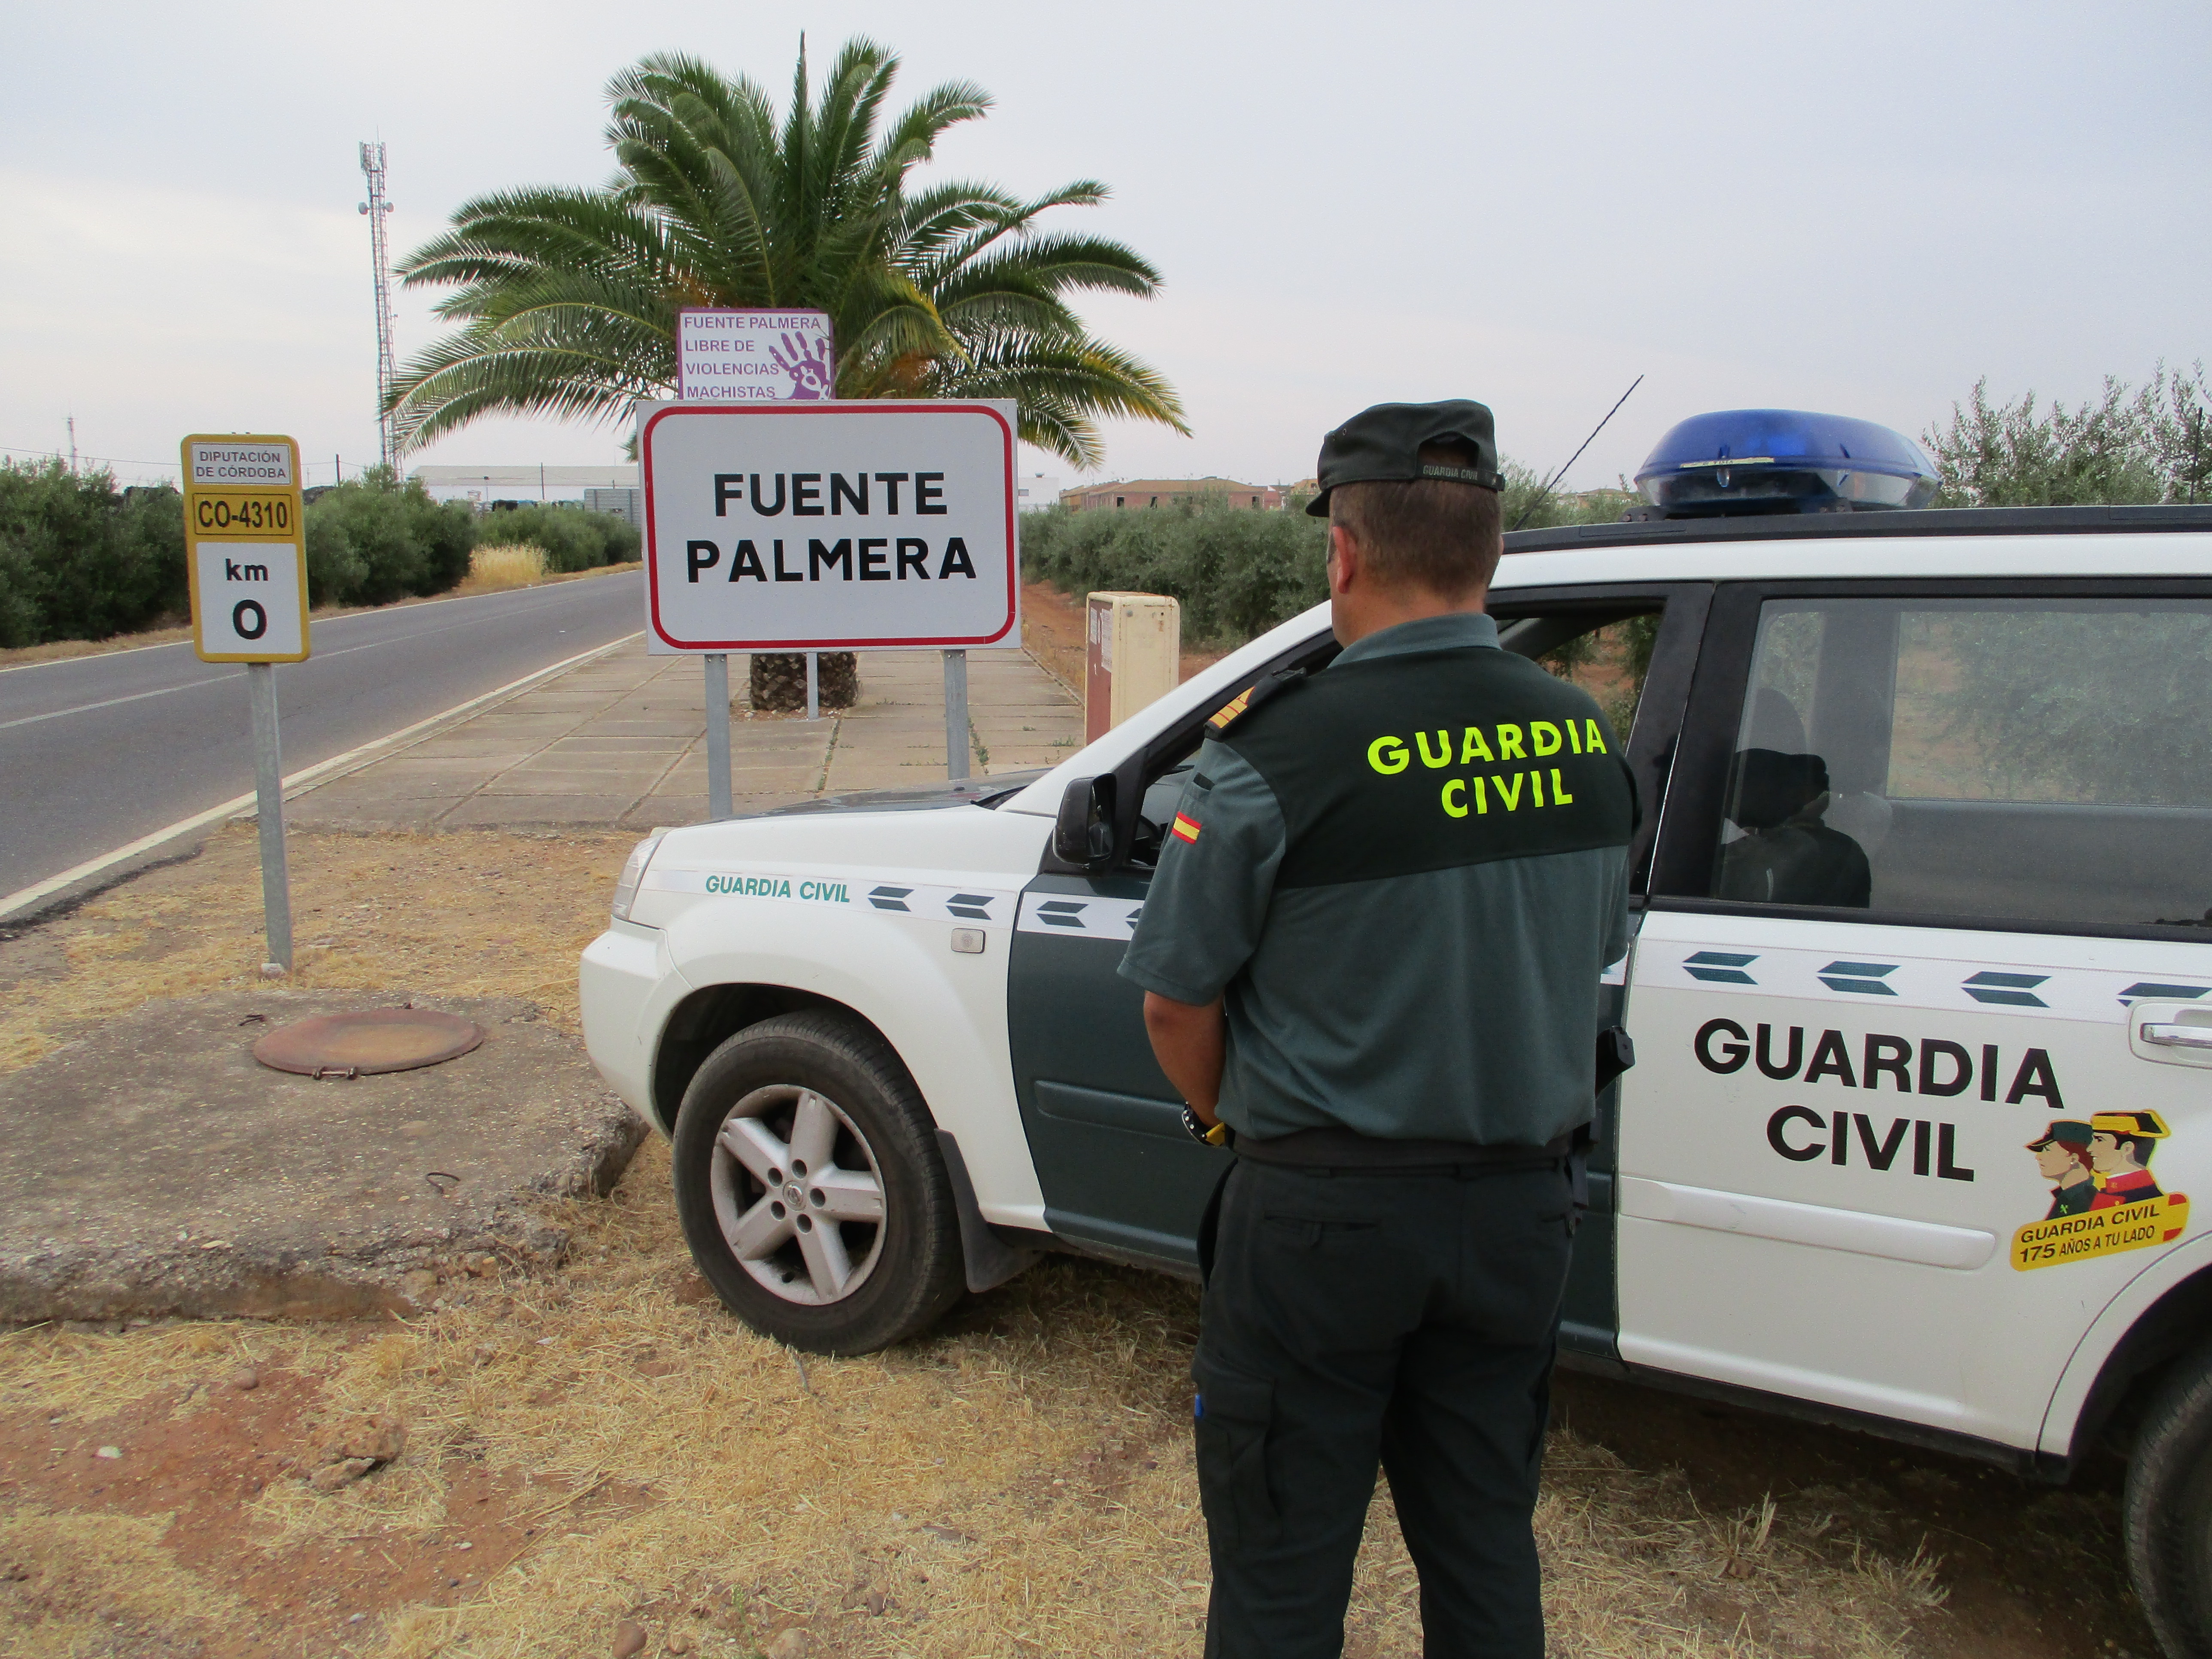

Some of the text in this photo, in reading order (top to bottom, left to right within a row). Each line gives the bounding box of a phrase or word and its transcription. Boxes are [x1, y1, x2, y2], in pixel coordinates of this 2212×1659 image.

[684, 317, 821, 329] FUENTE PALMERA
[686, 340, 755, 352] LIBRE DE
[686, 363, 779, 375] VIOLENCIAS
[687, 386, 775, 398] MACHISTAS
[200, 450, 280, 463] DIPUTACIÓN
[197, 465, 286, 478] DE CÓRDOBA
[1423, 465, 1477, 480] GUARDIA CIVIL
[714, 472, 948, 517] FUENTE
[198, 500, 288, 528] CO-4310
[225, 558, 269, 581] km
[687, 537, 976, 583] PALMERA
[232, 599, 267, 640] 0
[1367, 719, 1607, 775] GUARDIA
[1441, 768, 1573, 818] CIVIL
[706, 875, 850, 902] GUARDIA CIVIL
[1694, 1018, 2064, 1109] GUARDIA
[1766, 1105, 1974, 1182] CIVIL
[2021, 1204, 2160, 1243] GUARDIA CIVIL
[2020, 1225, 2155, 1262] 175 AÑOS A TU LADO
